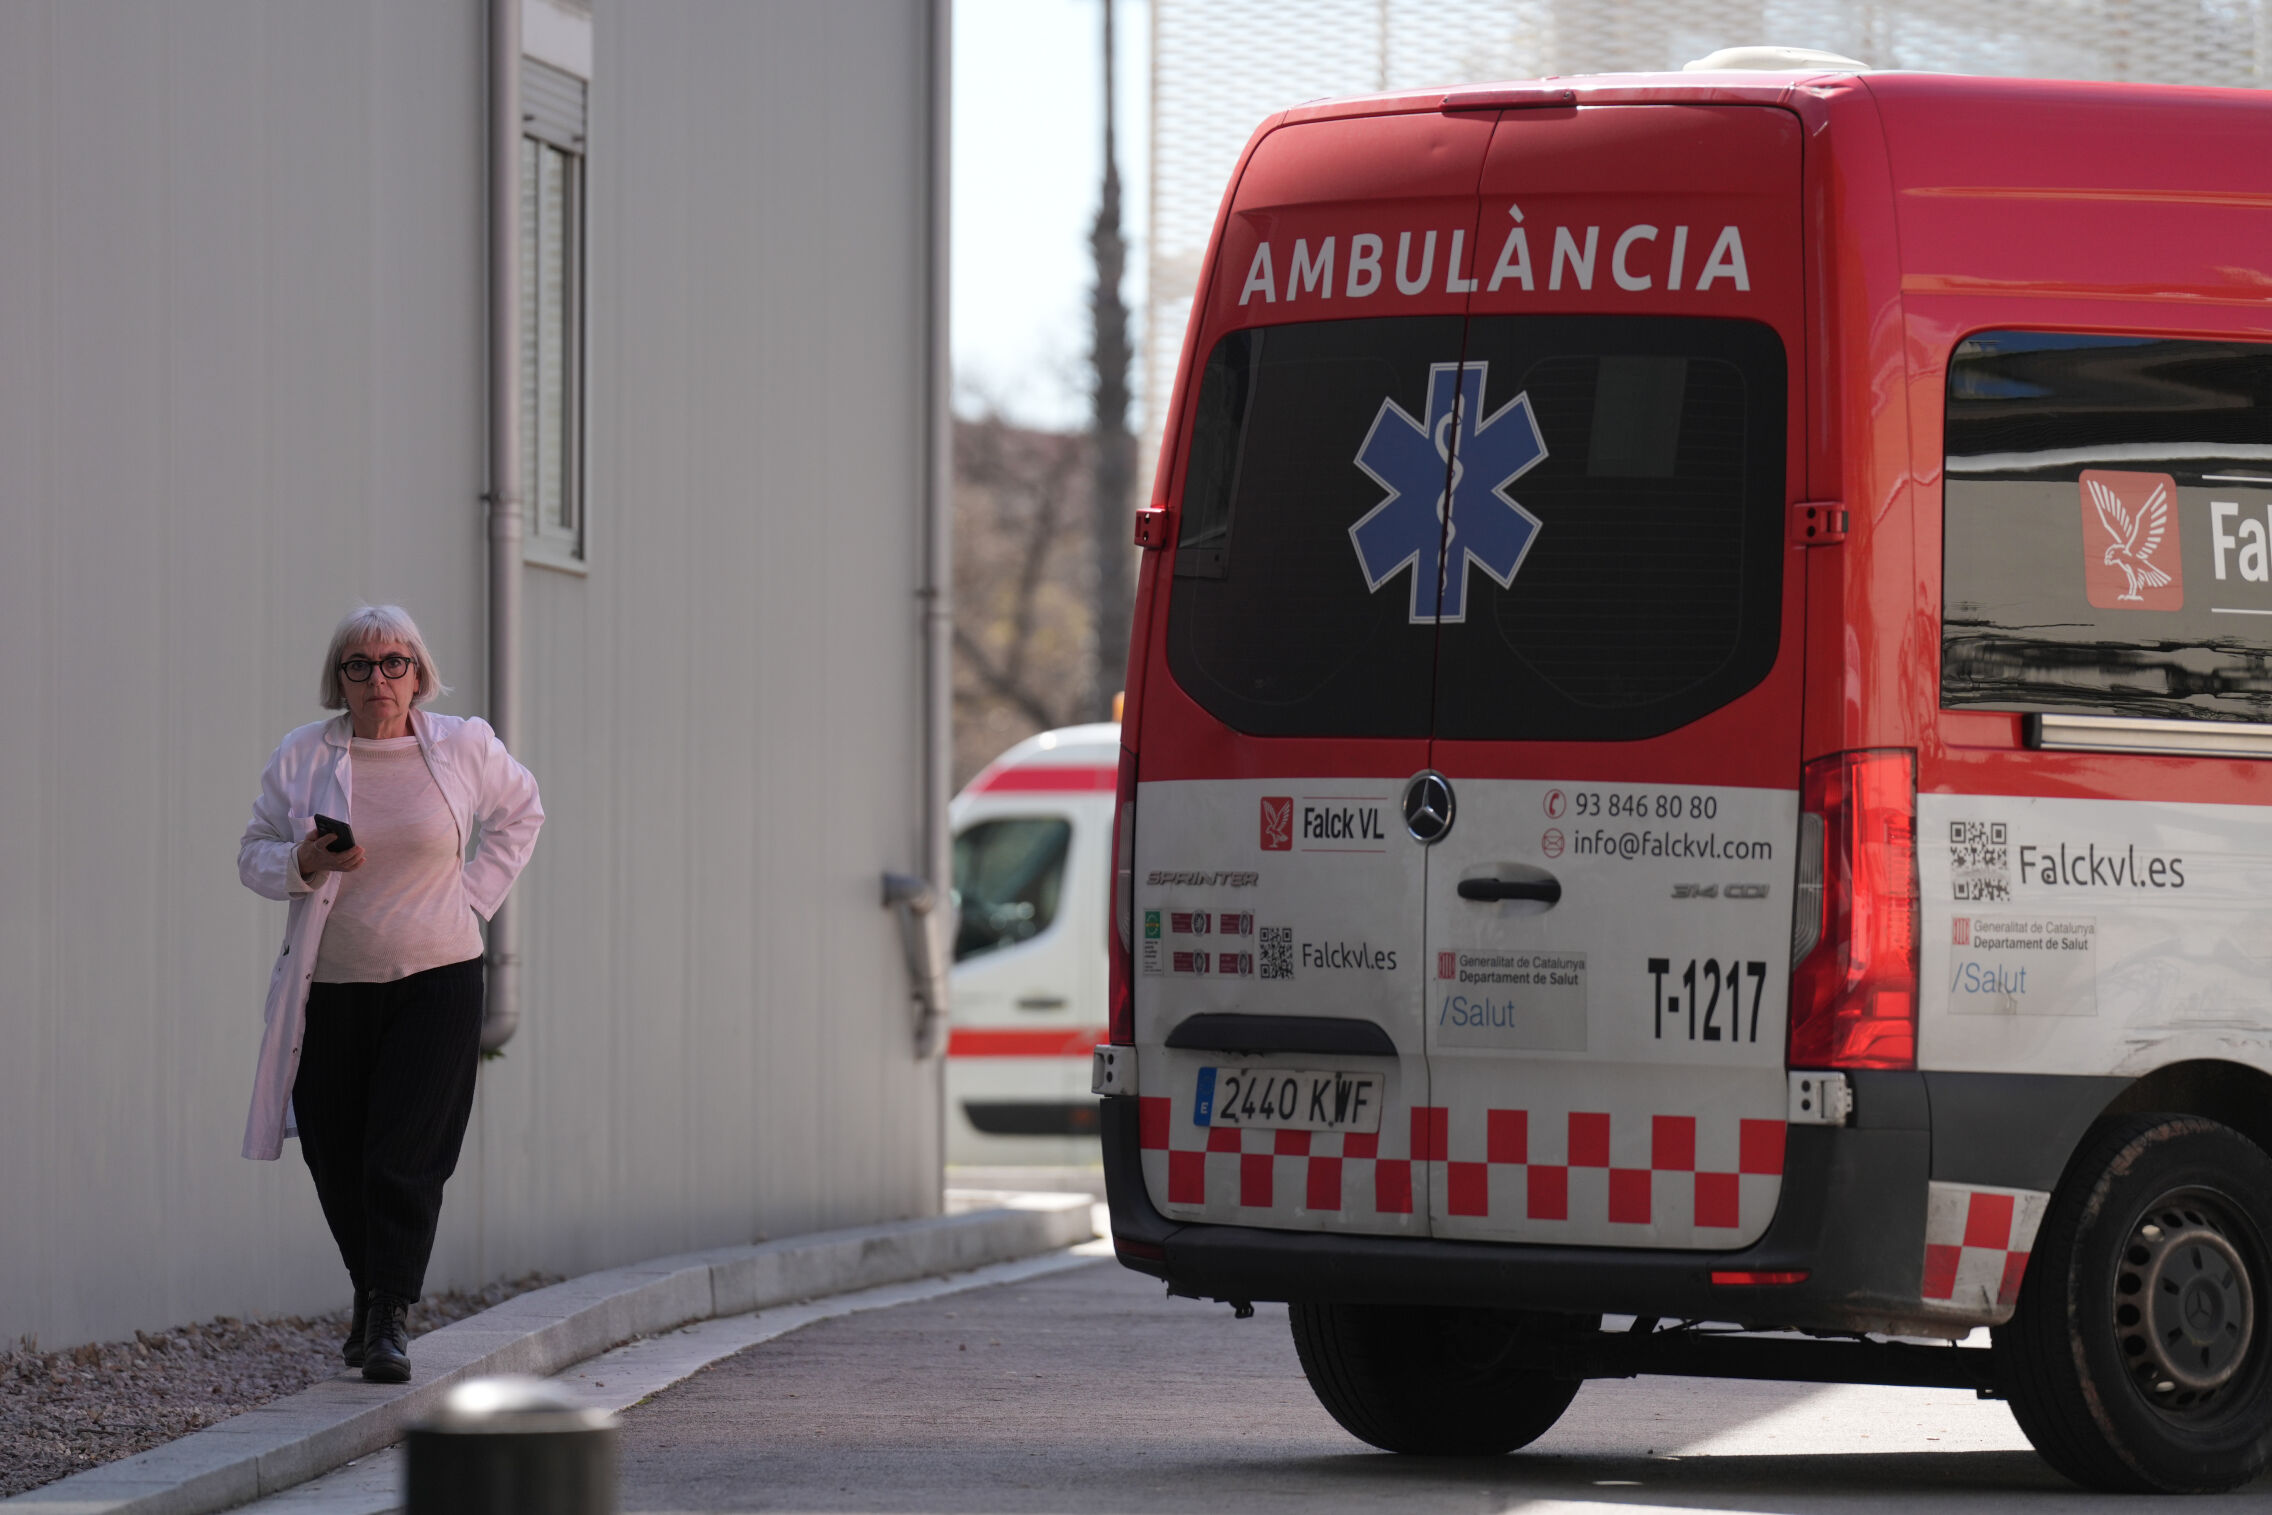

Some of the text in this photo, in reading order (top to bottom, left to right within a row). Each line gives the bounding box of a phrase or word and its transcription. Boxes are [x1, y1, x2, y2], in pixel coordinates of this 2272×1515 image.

[1238, 203, 1751, 305] AMBULÀNCIA
[2210, 501, 2272, 582] Fa
[1575, 792, 1717, 819] 93 846 80 80
[1303, 807, 1385, 840] Falck VL
[1574, 830, 1773, 860] info@falckvl.com
[1146, 870, 1260, 887] SPRINTER
[2019, 842, 2185, 888] Falckvl.es
[1723, 883, 1770, 899] CDI
[1974, 920, 2095, 937] Generalitat de Catalunya
[1302, 942, 1397, 970] Falckvl.es
[1974, 936, 2088, 951] Departament de Salut
[1459, 954, 1586, 973] Generalitat de Catalunya
[1460, 970, 1579, 986] Departament de Salut
[1952, 962, 2027, 994] /Salut
[1440, 995, 1515, 1028] /Salut
[1648, 957, 1767, 1043] T-1217
[1200, 1101, 1209, 1114] E
[1220, 1077, 1373, 1124] 2440 KWF
